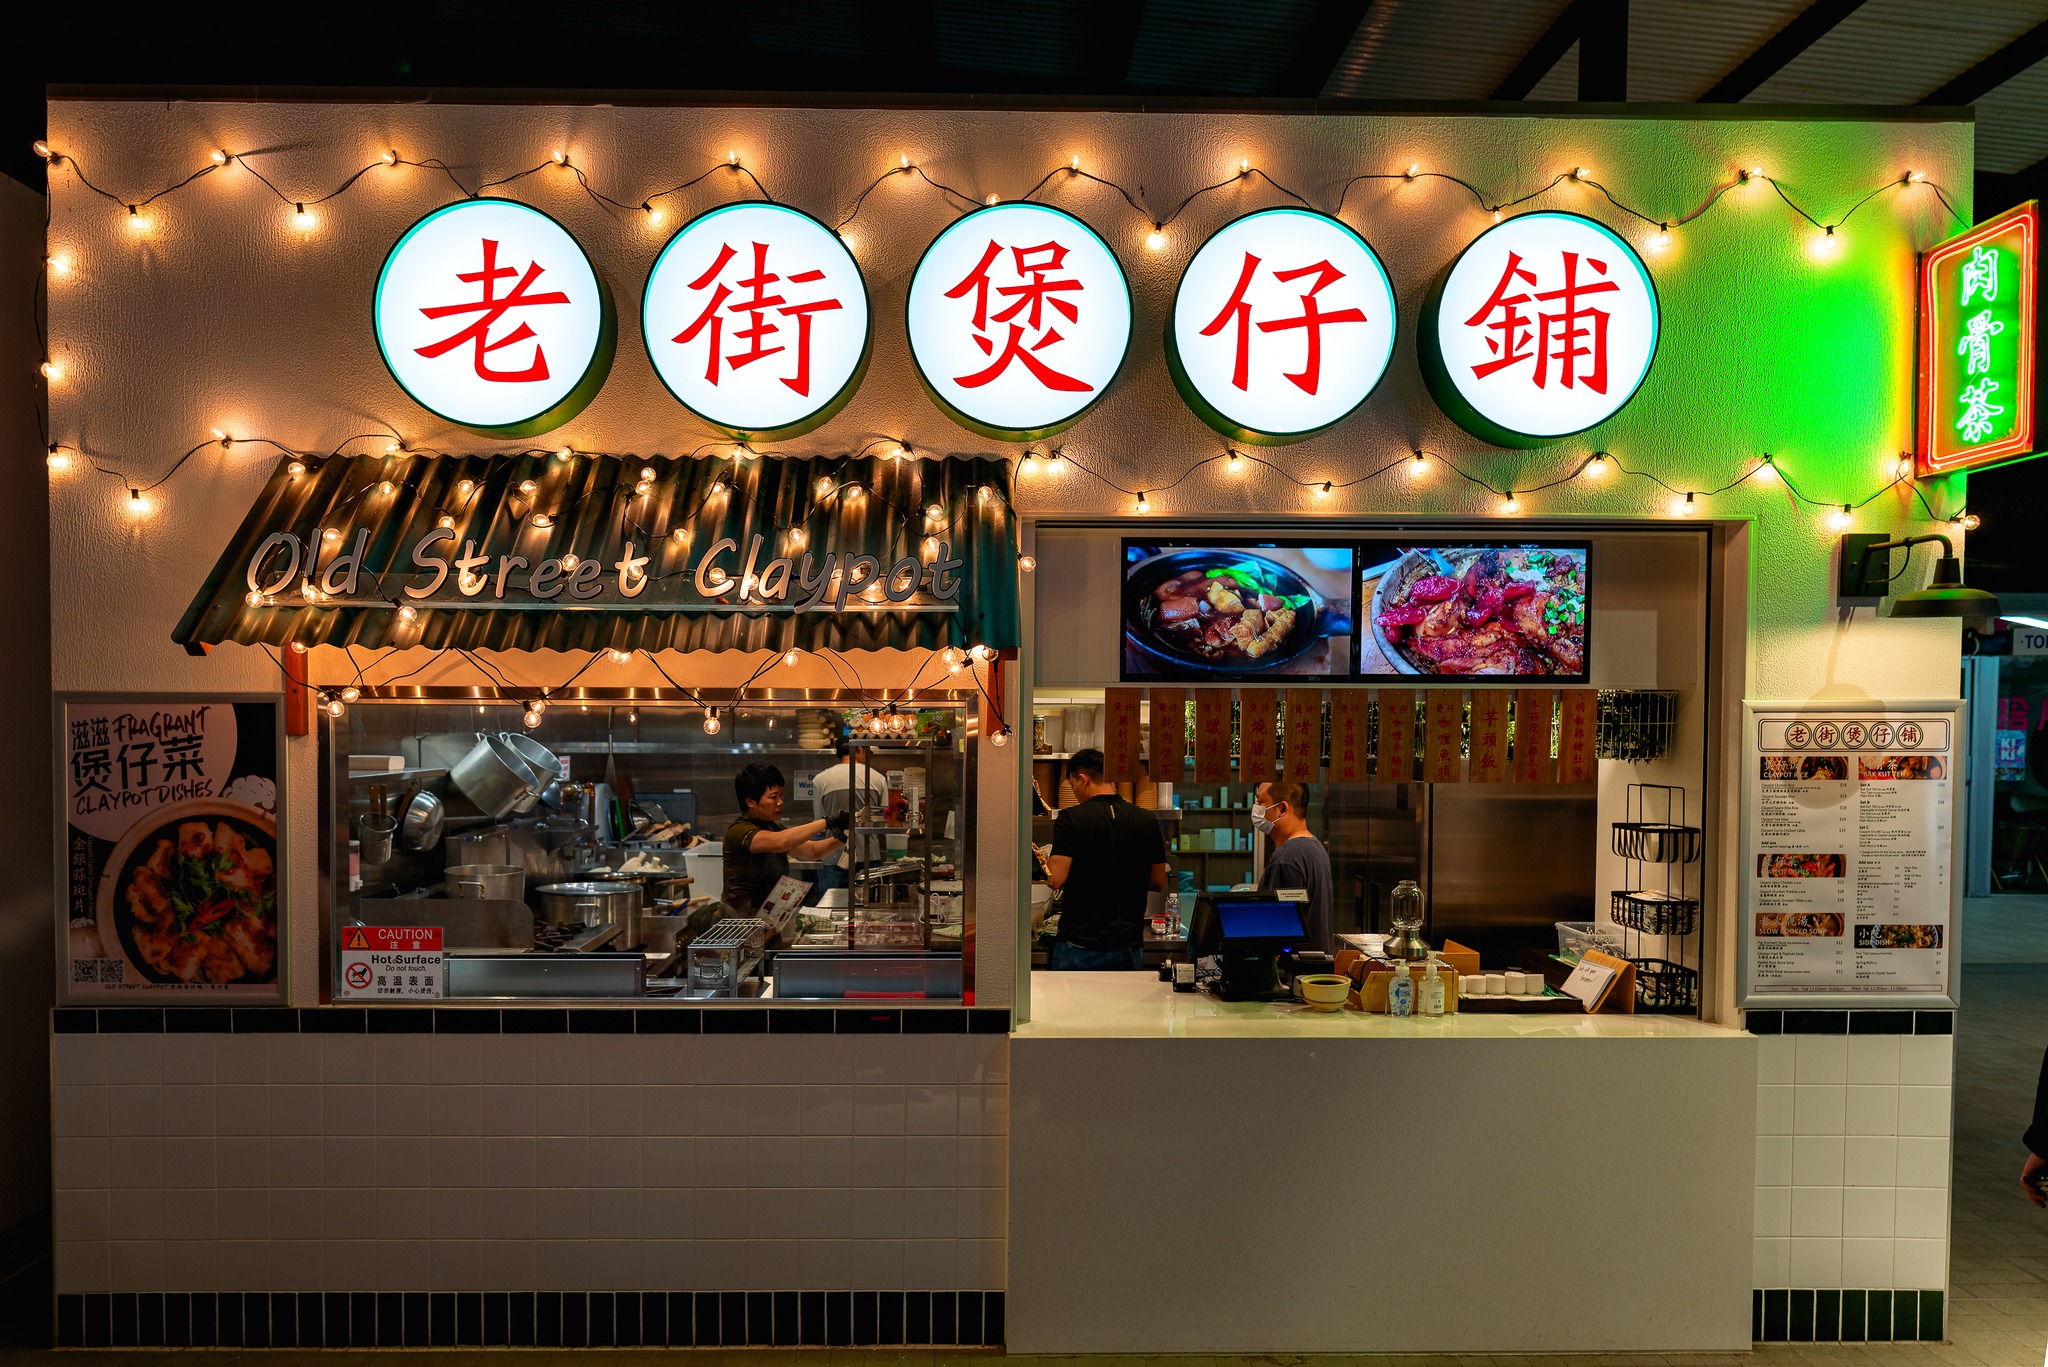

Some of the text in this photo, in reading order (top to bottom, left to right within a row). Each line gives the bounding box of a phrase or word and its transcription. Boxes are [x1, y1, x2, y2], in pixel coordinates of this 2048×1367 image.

[414, 238, 1621, 397] 老街煲仔鋪
[1957, 246, 2005, 443] 肉骨茶
[245, 526, 965, 614] Old Street Claypot
[2025, 634, 2048, 649] TO
[71, 717, 110, 750] 滋滋
[112, 705, 211, 743] FRAGRANT
[1480, 710, 1499, 769] 芋頭飯
[70, 734, 204, 798] 煲仔菜
[76, 778, 213, 815] CLAYPOT DISHES
[378, 929, 433, 940] CAUTION
[371, 954, 441, 965] Hot Surface
